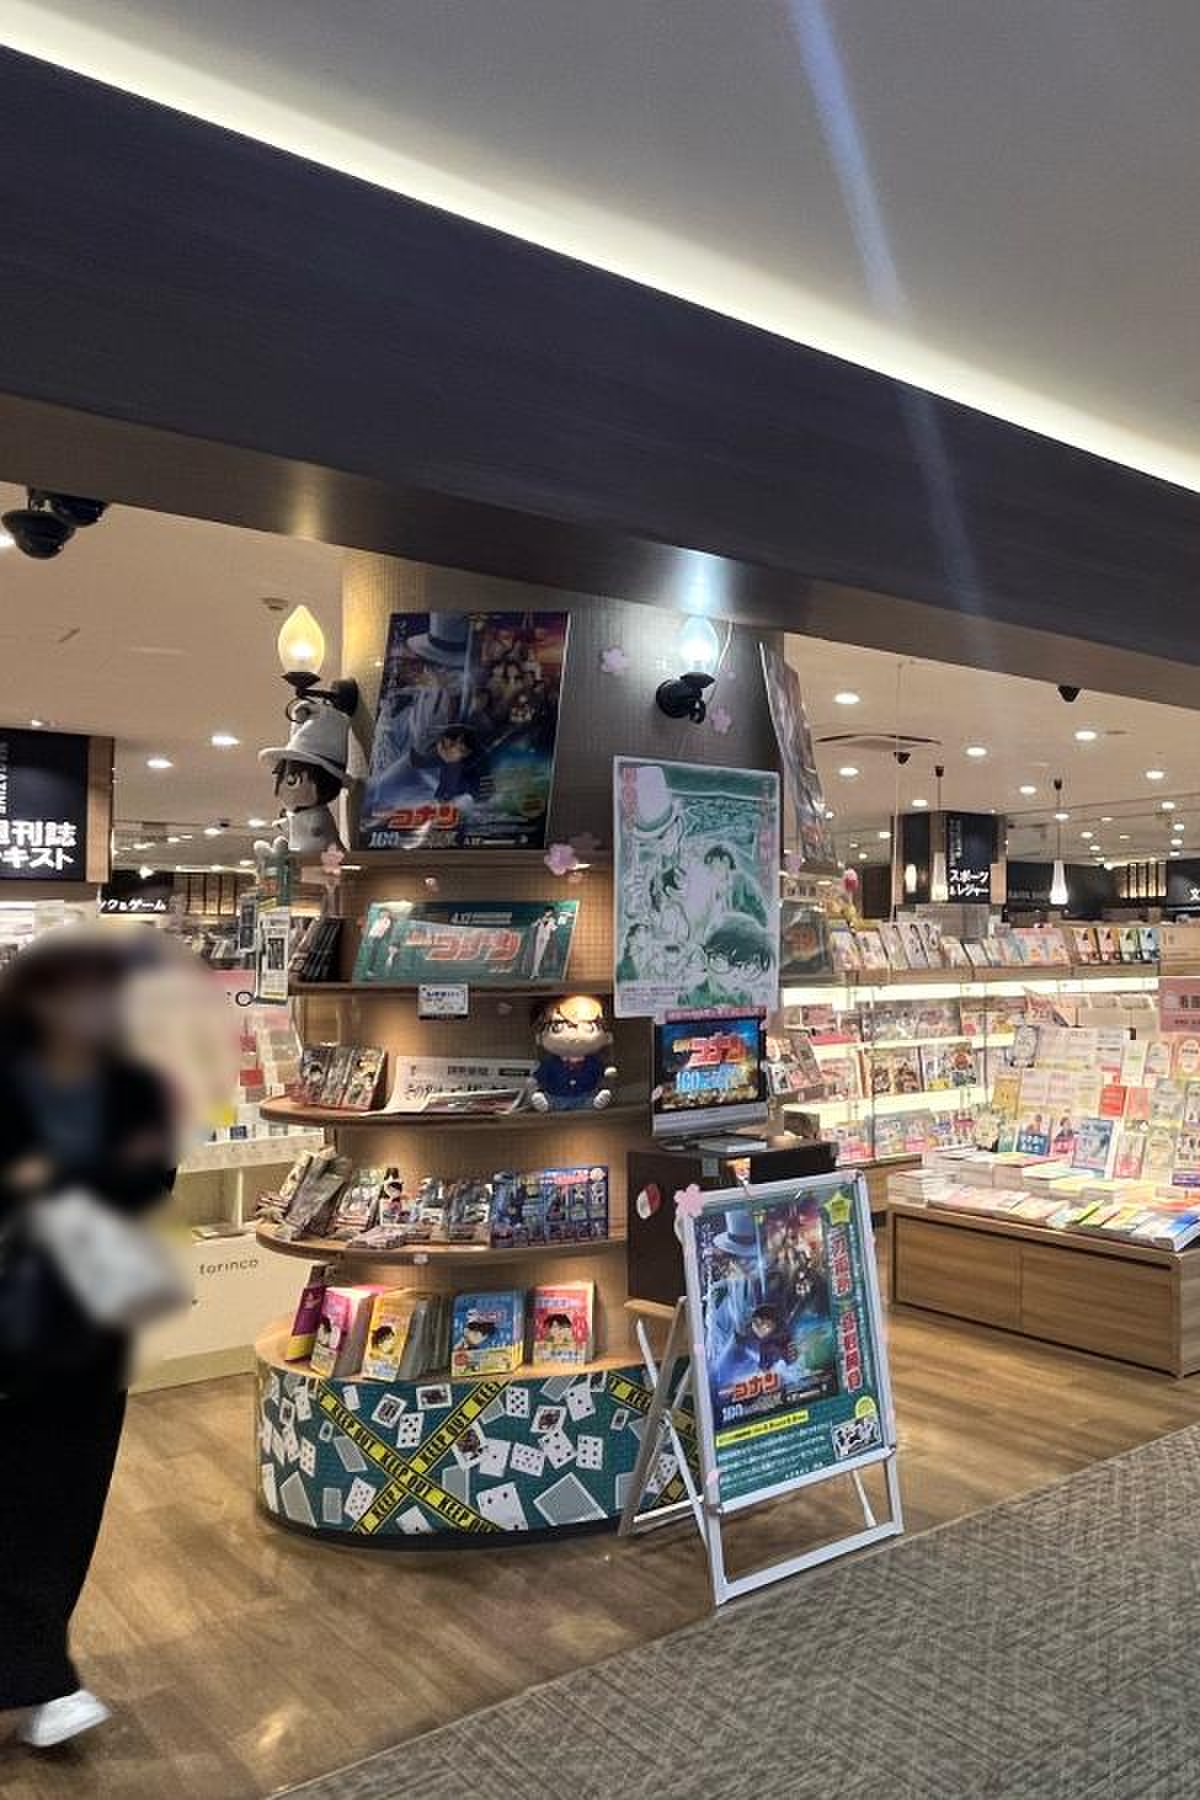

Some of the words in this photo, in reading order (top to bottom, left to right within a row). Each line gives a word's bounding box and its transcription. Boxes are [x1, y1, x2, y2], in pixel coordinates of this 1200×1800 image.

[0, 846, 75, 871] キスト
[331, 1402, 356, 1432] KEEP
[353, 1427, 377, 1452] OUT
[381, 1450, 410, 1481] KEEP
[407, 1473, 434, 1498] OUT
[438, 1496, 470, 1524] KEEP
[371, 1487, 400, 1520] KEEP
[418, 1437, 448, 1464] KEEP
[445, 1411, 472, 1437] OUT
